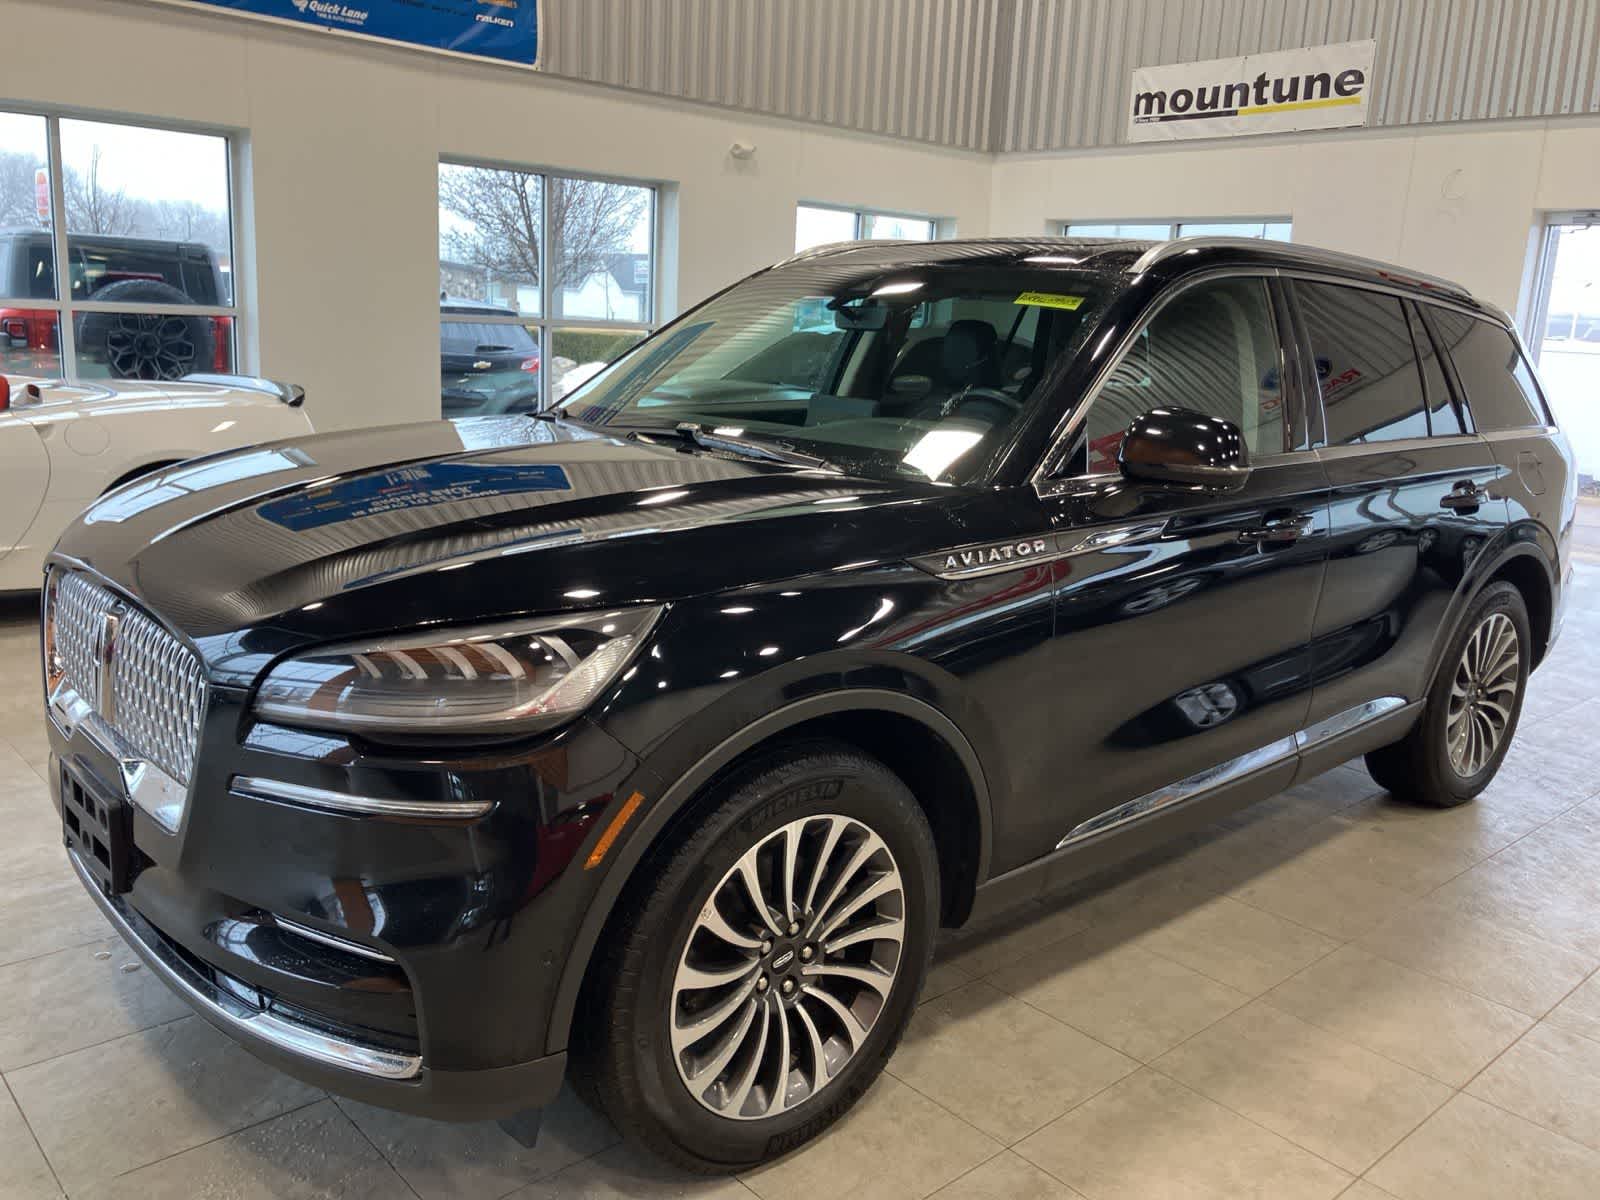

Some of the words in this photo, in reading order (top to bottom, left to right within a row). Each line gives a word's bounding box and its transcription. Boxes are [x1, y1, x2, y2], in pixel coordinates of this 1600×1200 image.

[309, 1, 341, 14] Quick
[341, 6, 368, 20] Lane
[1133, 68, 1365, 117] mountune
[945, 539, 1046, 569] AVIATOR
